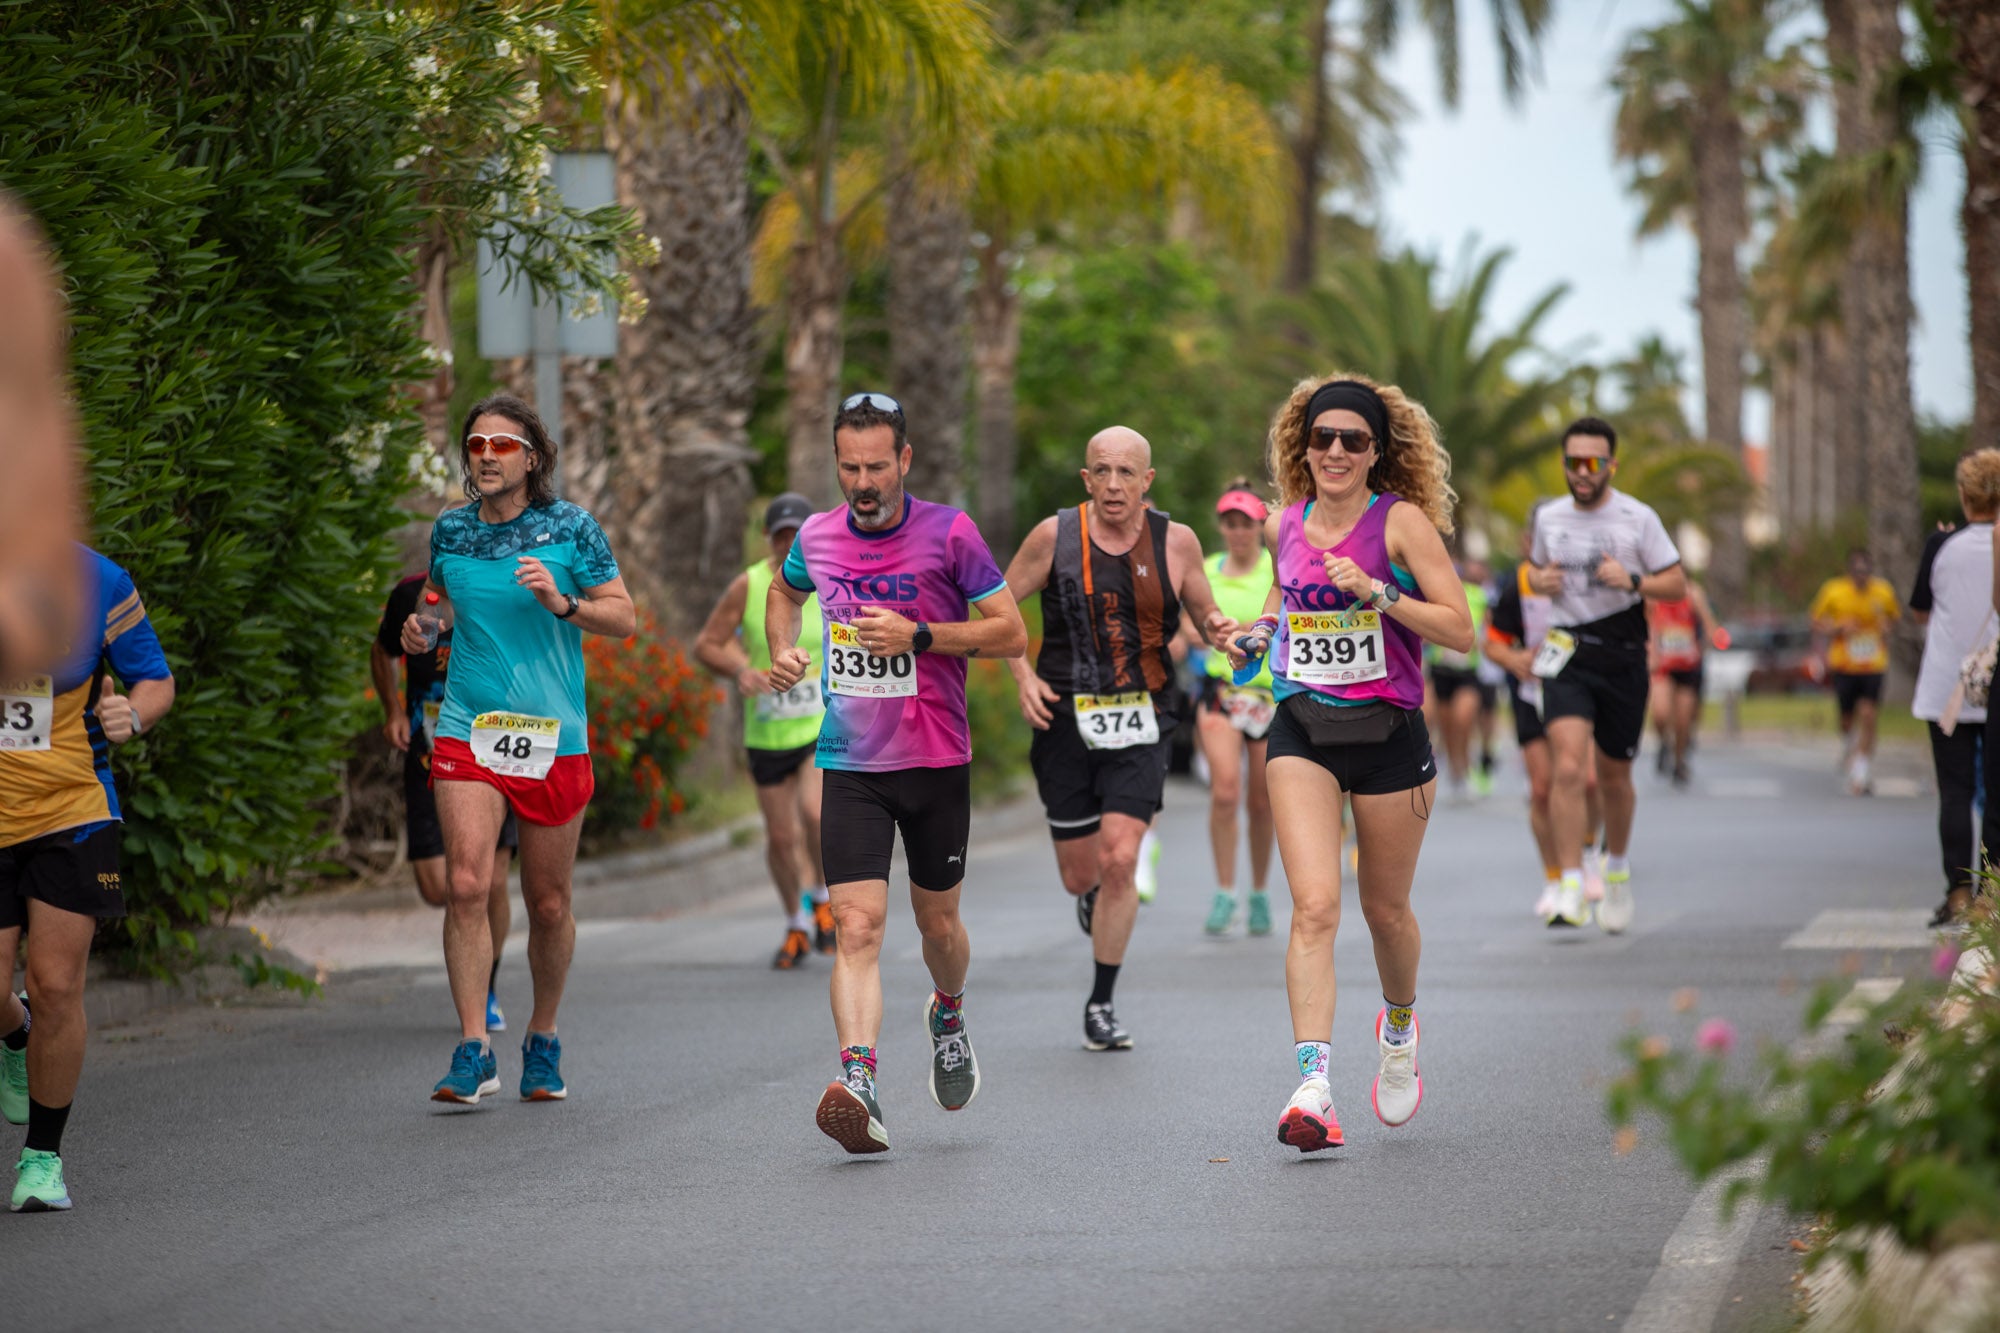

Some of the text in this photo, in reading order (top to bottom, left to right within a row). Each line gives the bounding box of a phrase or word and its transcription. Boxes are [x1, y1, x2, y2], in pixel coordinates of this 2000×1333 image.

[860, 552, 883, 561] vive
[1310, 559, 1324, 567] viv
[1300, 617, 1360, 630] 38 FONO
[1102, 592, 1131, 687] RUNNING
[1293, 635, 1377, 665] 3391
[831, 648, 912, 679] 3390
[485, 715, 499, 725] 38
[1090, 710, 1144, 735] 374
[493, 734, 532, 759] 48
